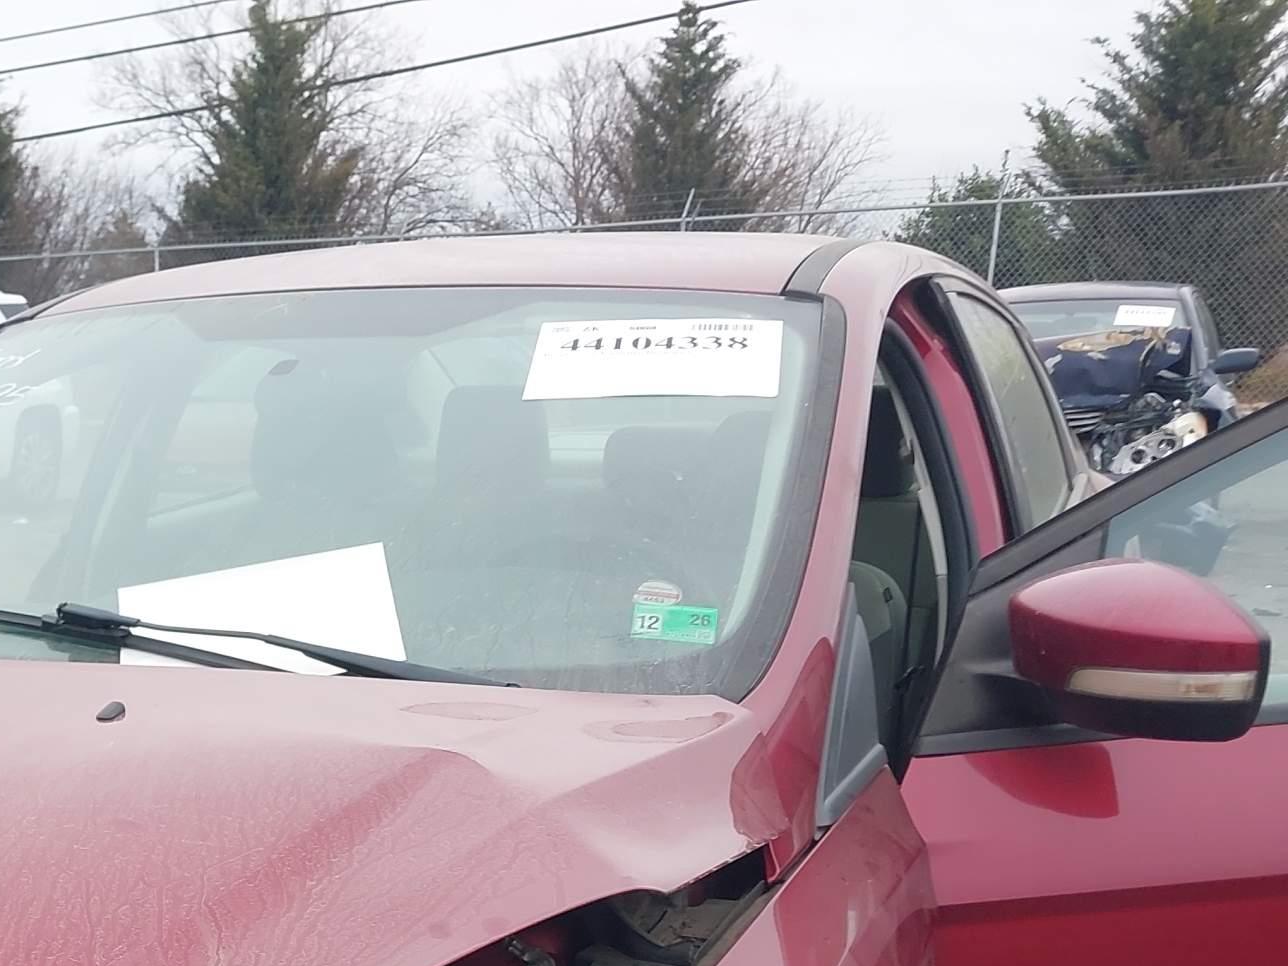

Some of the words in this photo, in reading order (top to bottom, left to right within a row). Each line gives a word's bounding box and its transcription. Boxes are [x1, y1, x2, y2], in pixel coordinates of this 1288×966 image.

[560, 335, 749, 352] 44104338
[637, 615, 661, 630] 12
[688, 613, 711, 627] 26
